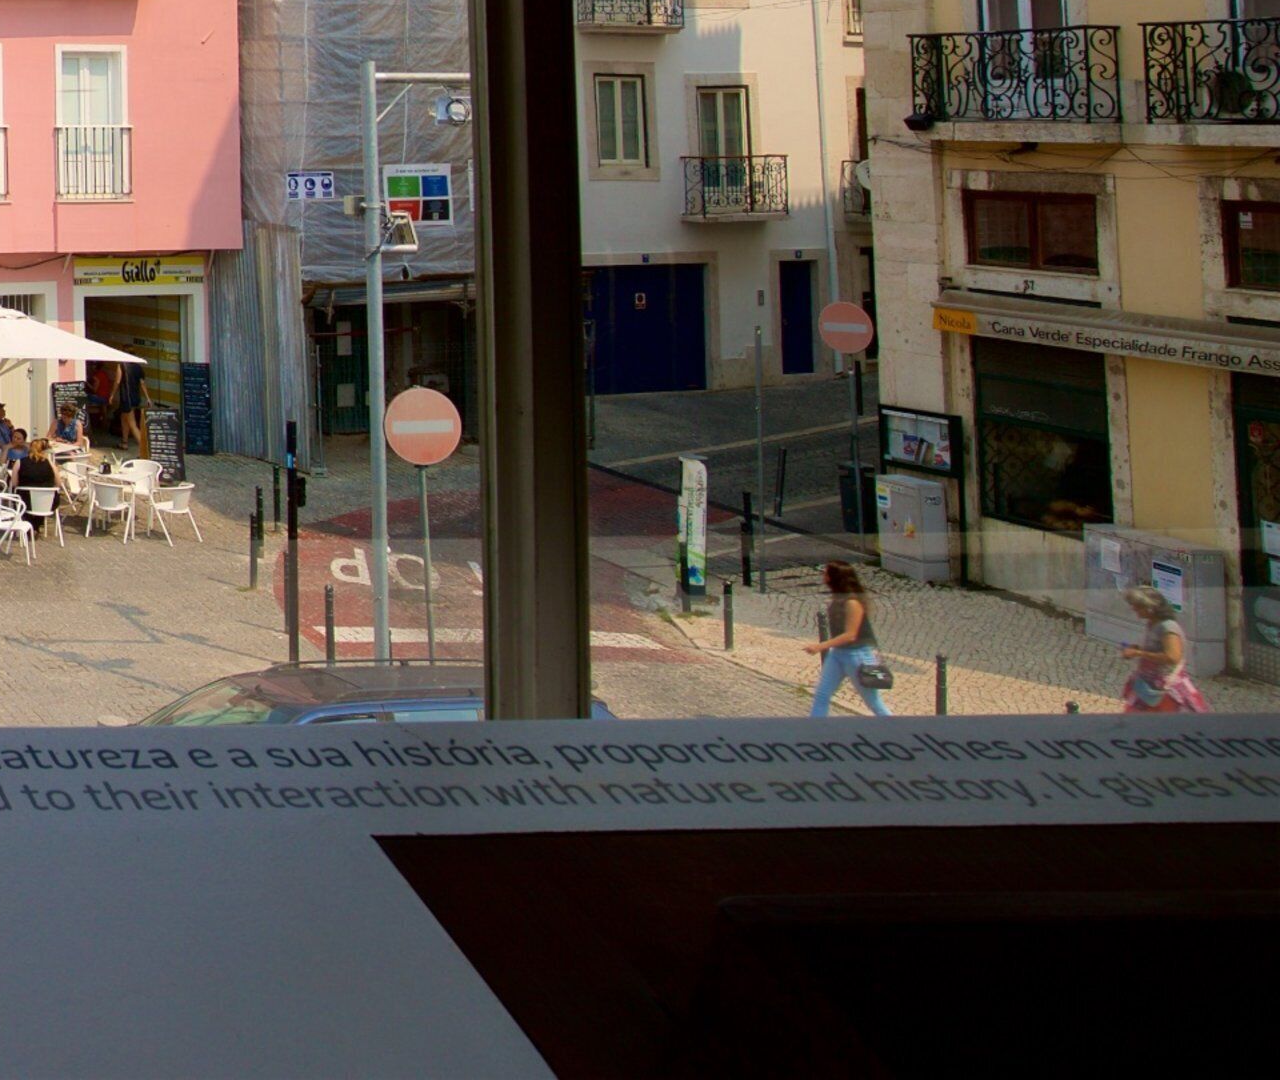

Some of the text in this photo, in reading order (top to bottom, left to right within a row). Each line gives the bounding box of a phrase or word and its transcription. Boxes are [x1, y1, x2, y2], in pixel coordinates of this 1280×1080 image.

[121, 259, 157, 284] Giallo
[939, 314, 973, 331] Nicola
[1075, 332, 1178, 357] Especialidade
[1180, 345, 1242, 367] Frango
[187, 745, 217, 770] e
[230, 744, 257, 769] a
[271, 744, 352, 769] sua
[353, 737, 553, 770] história,
[553, 732, 1029, 773] proporcionando-lhes
[1024, 738, 1115, 760] um
[19, 783, 74, 812] to
[81, 780, 215, 811] their
[208, 778, 480, 810] interaction
[483, 774, 592, 808] with
[598, 776, 766, 807] nature
[766, 771, 868, 804] and
[854, 771, 1052, 807] history.
[1040, 771, 1104, 800] It
[1098, 771, 1233, 808] gives
